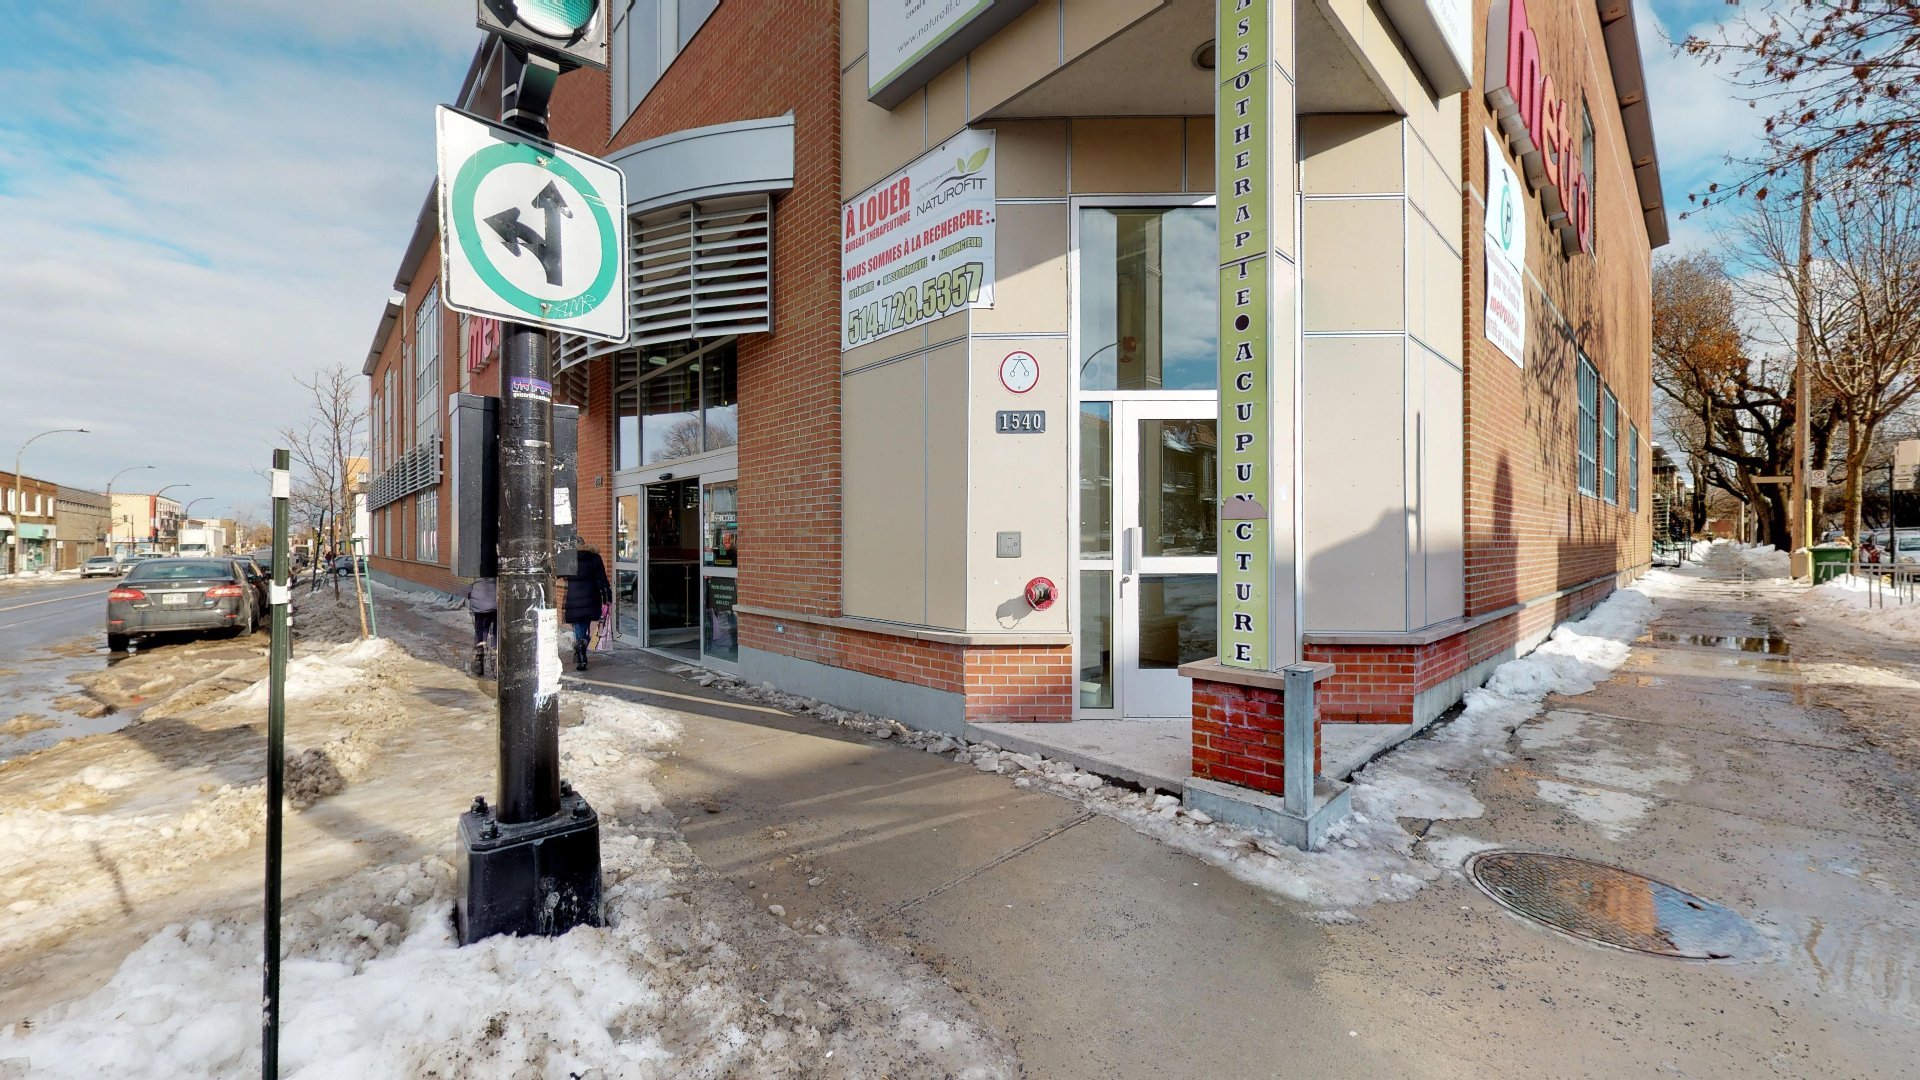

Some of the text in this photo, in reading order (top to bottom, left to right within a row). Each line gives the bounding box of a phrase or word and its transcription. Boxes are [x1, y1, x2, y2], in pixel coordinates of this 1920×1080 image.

[1507, 0, 1590, 254] metro
[846, 204, 856, 240] À
[859, 176, 910, 232] LOUER
[916, 177, 987, 216] NATUROFIT
[845, 210, 911, 254] BUREAU THÉRAPEUTIQUE
[846, 261, 867, 283] NOUS
[867, 243, 902, 273] SOMMES
[903, 238, 910, 257] À
[911, 233, 922, 253] LA
[923, 209, 984, 246] RECHERCHE
[938, 236, 983, 260] ACUPUNCTEUR
[848, 262, 983, 345] 514.728.5357
[1001, 413, 1041, 430] 1540
